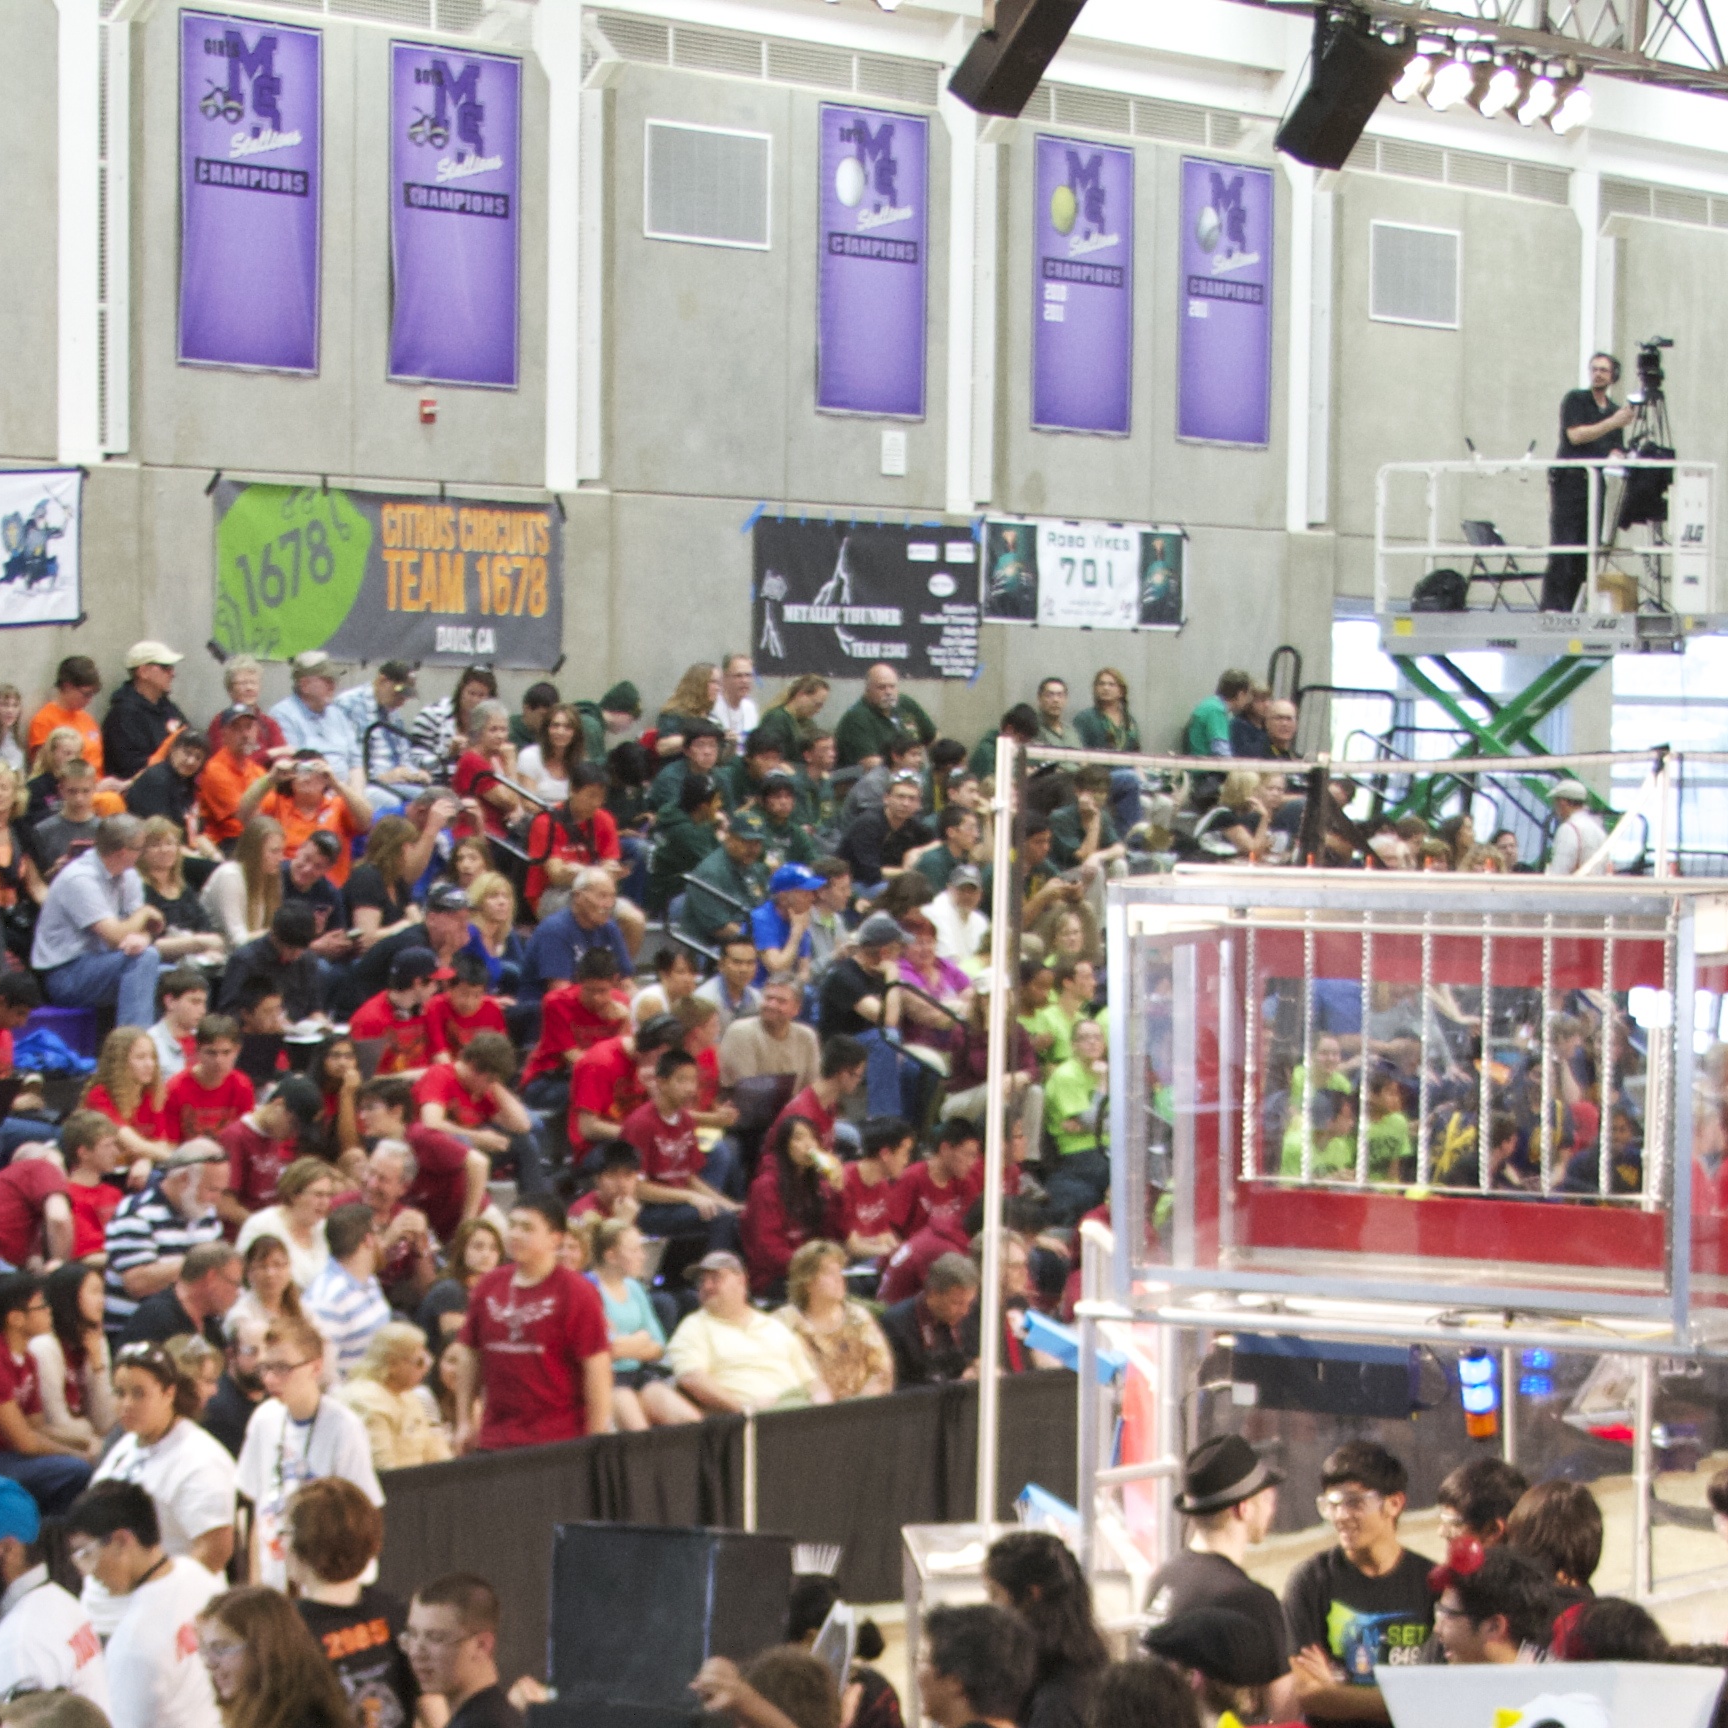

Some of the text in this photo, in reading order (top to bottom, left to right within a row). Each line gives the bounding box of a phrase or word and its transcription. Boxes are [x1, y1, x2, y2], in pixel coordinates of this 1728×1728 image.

[198, 162, 307, 195] CHAMPIONS
[408, 188, 508, 217] CHAMPIONS
[831, 235, 917, 261] CHAMPIONS
[1045, 262, 1122, 286] CHAMPIONS
[1190, 279, 1263, 303] CHAMPIONS
[381, 501, 550, 556] CITRUS CIRCUITS
[235, 517, 335, 617] 1678
[1058, 556, 1114, 588] 701
[381, 549, 548, 618] TEAM 1678
[476, 626, 496, 654] CA
[851, 641, 881, 659] TEAM
